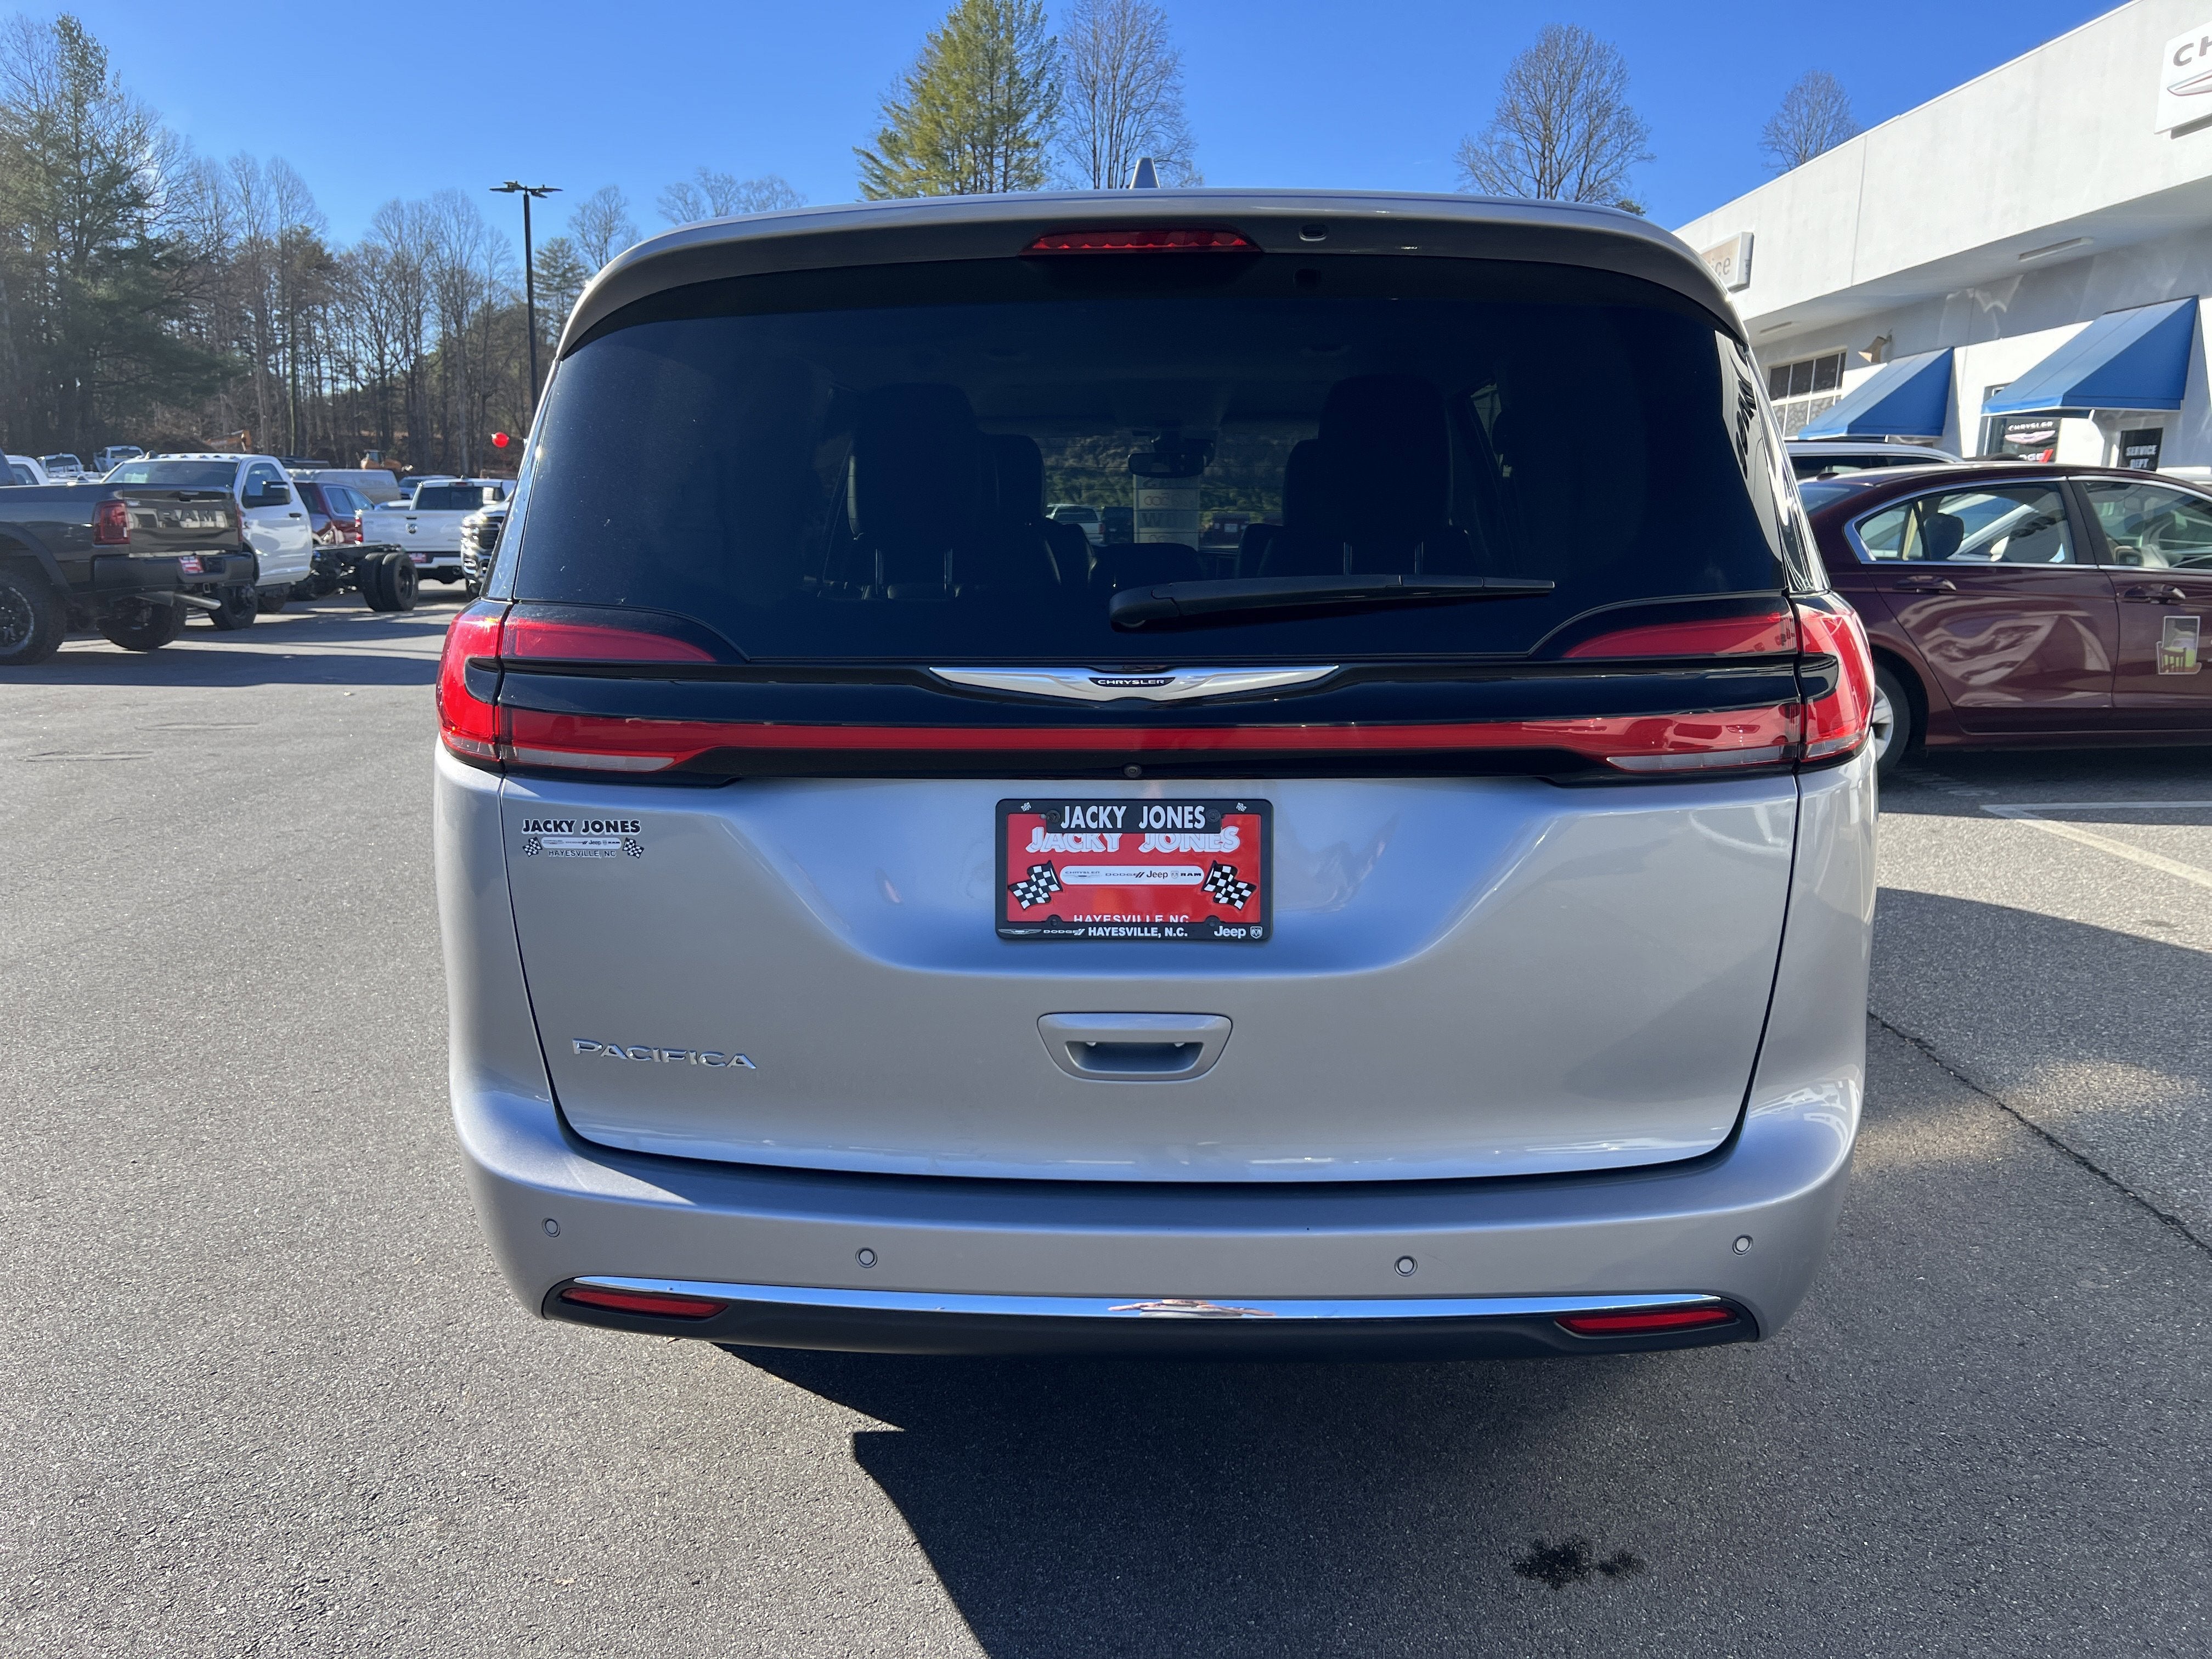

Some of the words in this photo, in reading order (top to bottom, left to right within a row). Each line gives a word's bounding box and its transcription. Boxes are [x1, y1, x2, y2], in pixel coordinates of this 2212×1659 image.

[1060, 805, 1127, 829] JACKY
[1138, 805, 1206, 829] JONES
[522, 819, 577, 834] JACKY
[581, 819, 641, 834] JONES
[1026, 827, 1123, 853] JACKY
[1138, 826, 1240, 853] JONES
[1147, 871, 1168, 879] Jeep
[1088, 927, 1161, 938] HAYESVILLE,
[1166, 927, 1188, 936] N.C.
[1214, 926, 1246, 939] Jeep
[572, 1038, 757, 1070] PACIFICA
